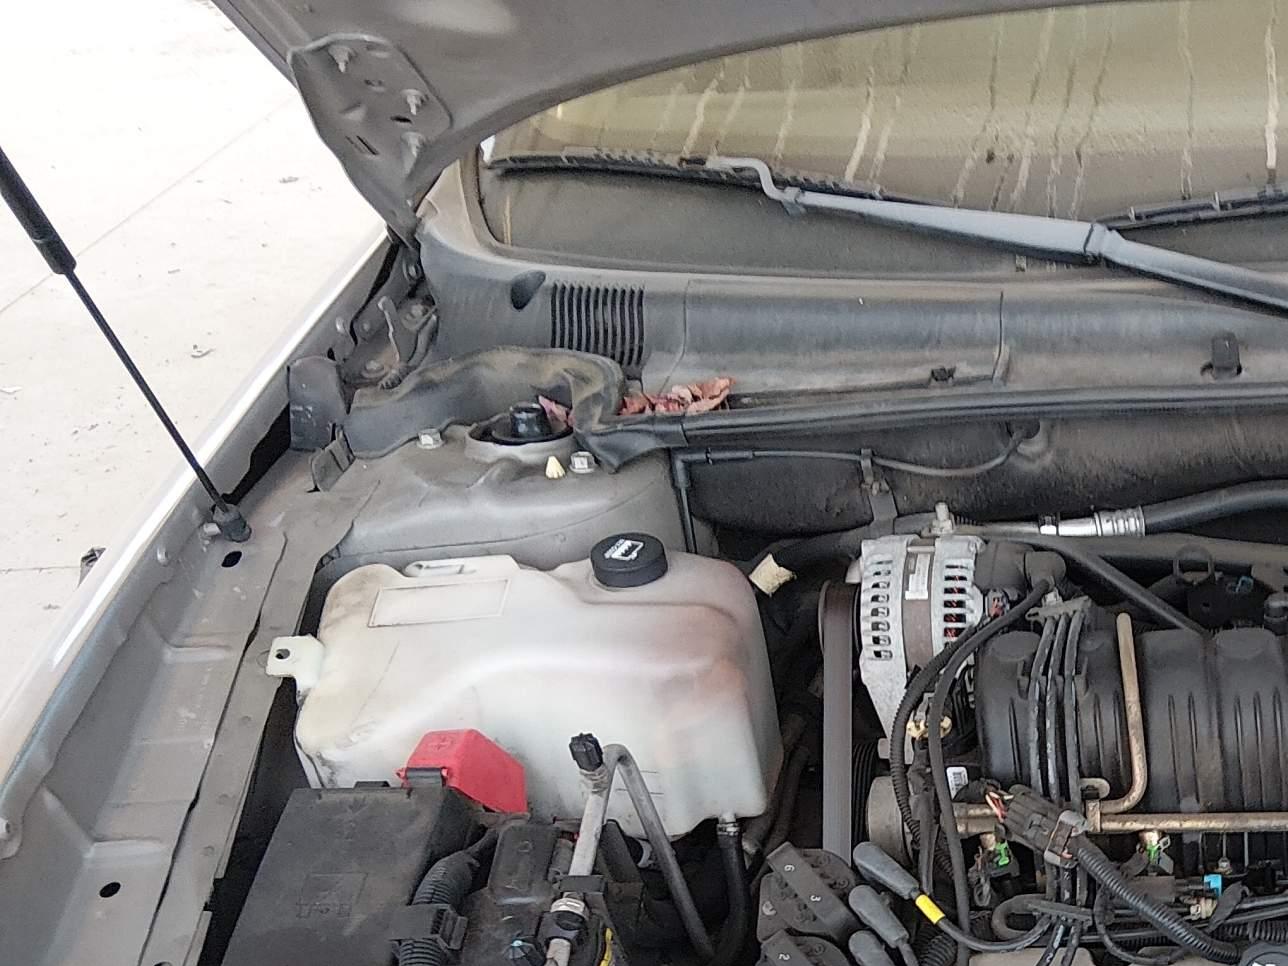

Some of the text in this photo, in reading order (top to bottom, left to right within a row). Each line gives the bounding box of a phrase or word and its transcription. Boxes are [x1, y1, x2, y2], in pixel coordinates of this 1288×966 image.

[783, 863, 796, 873] 6
[809, 894, 822, 903] 3
[778, 952, 791, 962] 2
